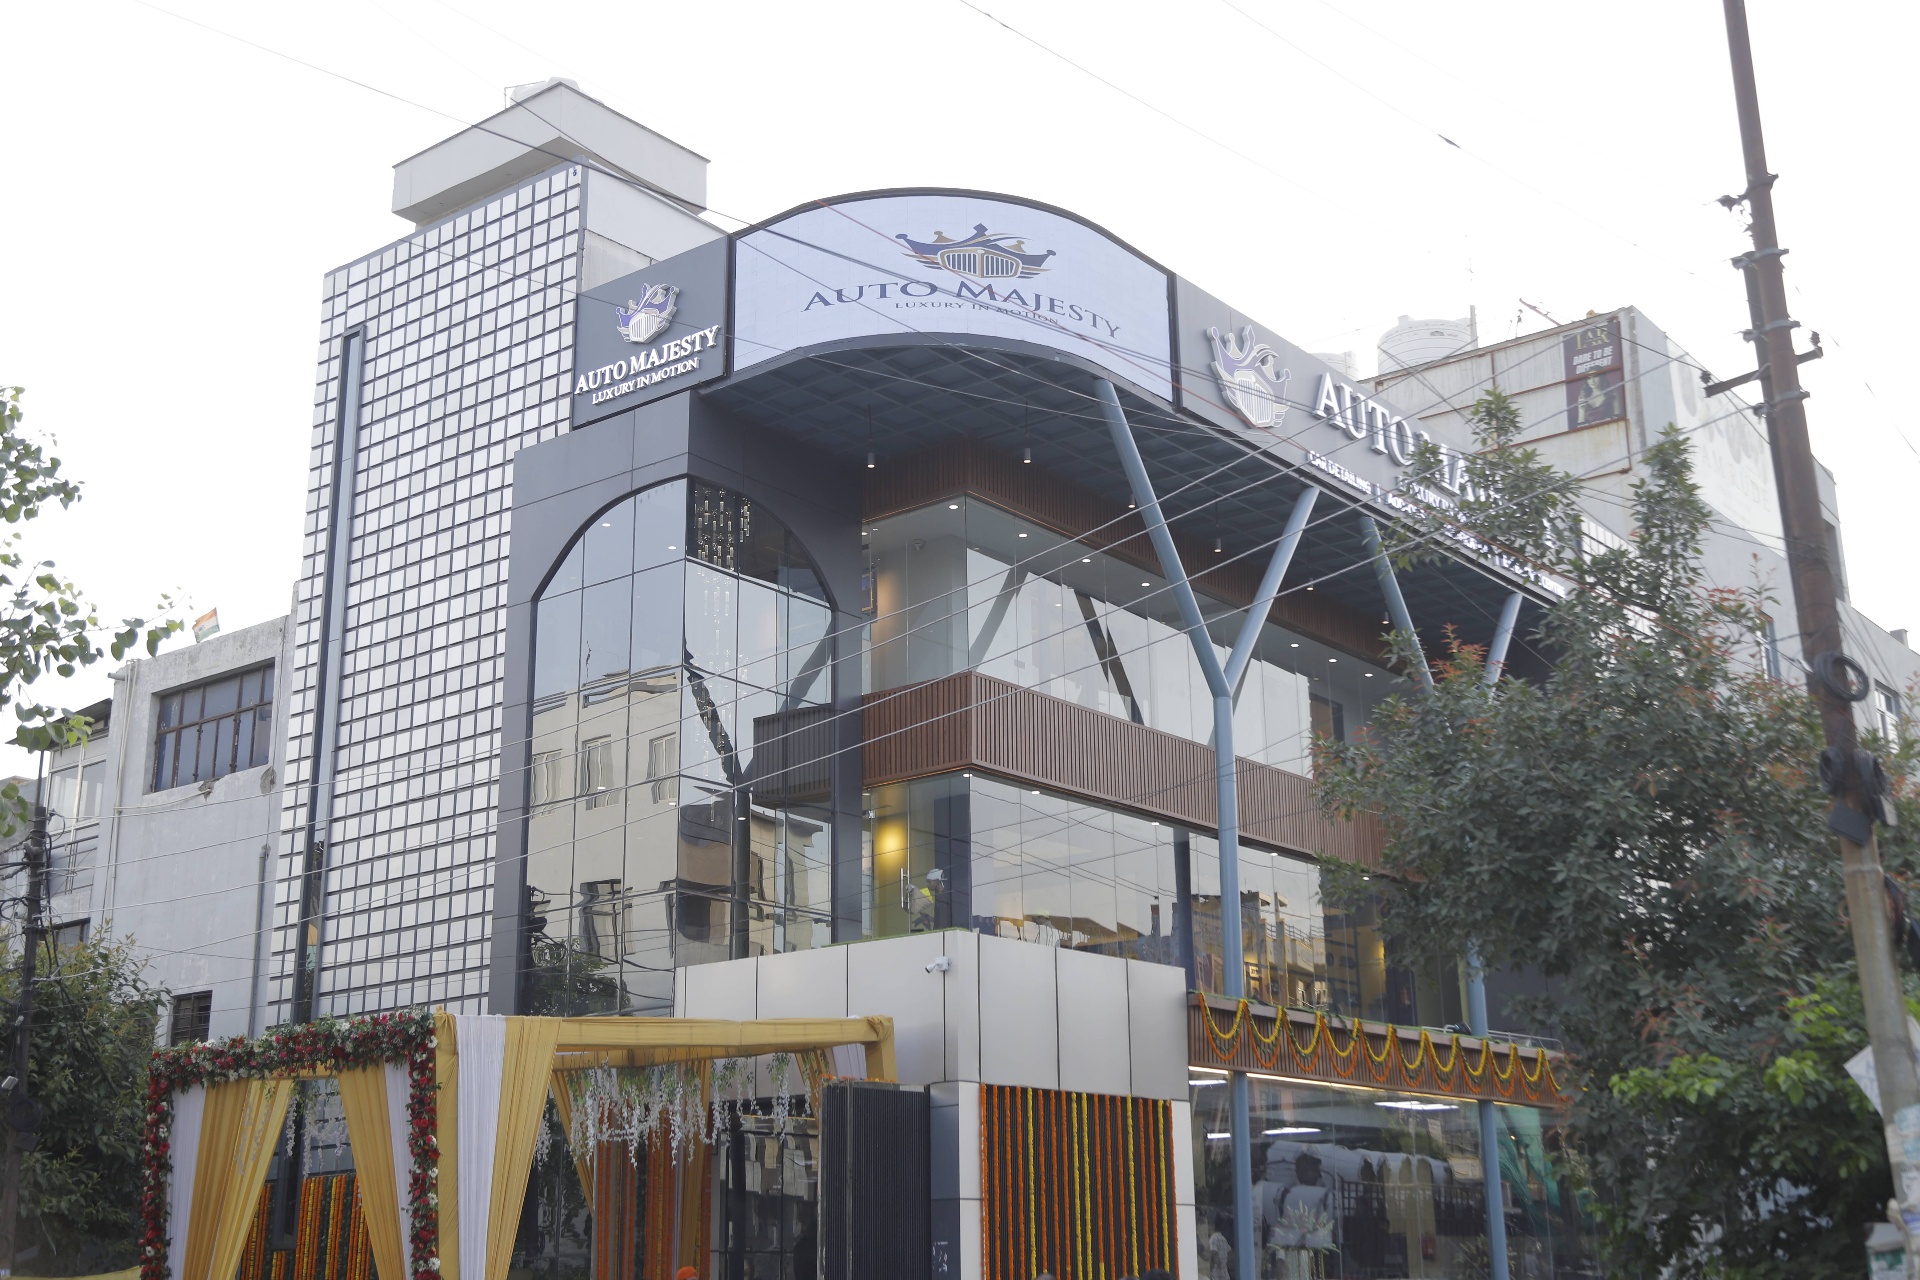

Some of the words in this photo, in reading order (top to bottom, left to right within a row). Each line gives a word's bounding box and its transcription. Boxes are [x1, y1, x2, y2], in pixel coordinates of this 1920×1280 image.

[801, 281, 938, 312] AUTO
[956, 280, 1121, 339] MAJESTY
[972, 303, 989, 311] IN
[996, 308, 1058, 325] MOTION
[574, 360, 629, 395] AUTO
[629, 324, 721, 376] MAJESTY
[1572, 352, 1592, 366] DARE
[1593, 349, 1603, 360] TO
[1603, 346, 1614, 357] BE
[591, 379, 636, 405] LUXURY
[636, 374, 650, 390] IN
[650, 357, 700, 384] MOTION
[1314, 371, 1415, 466] AUTO
[1309, 450, 1328, 472] CAR
[1328, 459, 1372, 495] DETAILING
